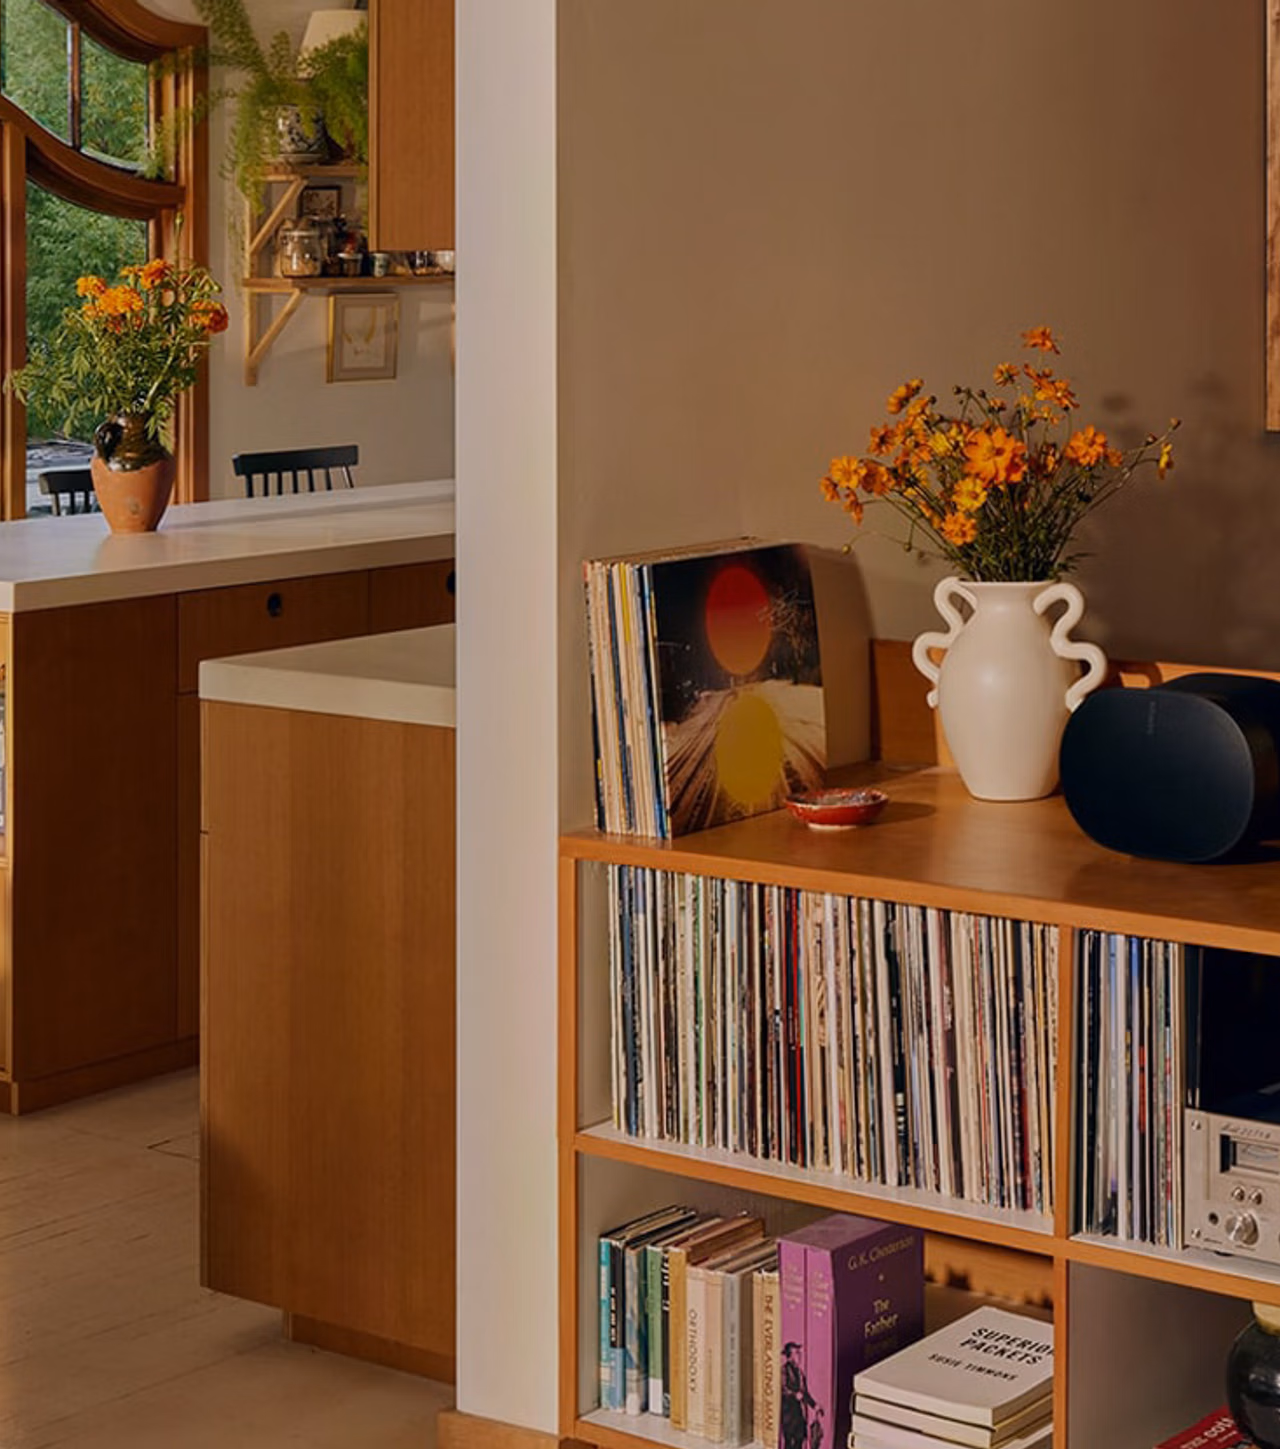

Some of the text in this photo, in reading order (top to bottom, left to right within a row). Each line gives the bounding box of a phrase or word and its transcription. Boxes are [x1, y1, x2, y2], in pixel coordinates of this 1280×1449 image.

[688, 1308, 698, 1392] ORTHODOXY
[764, 1320, 773, 1396] EVERLASTING
[960, 1338, 1042, 1365] PACKETS
